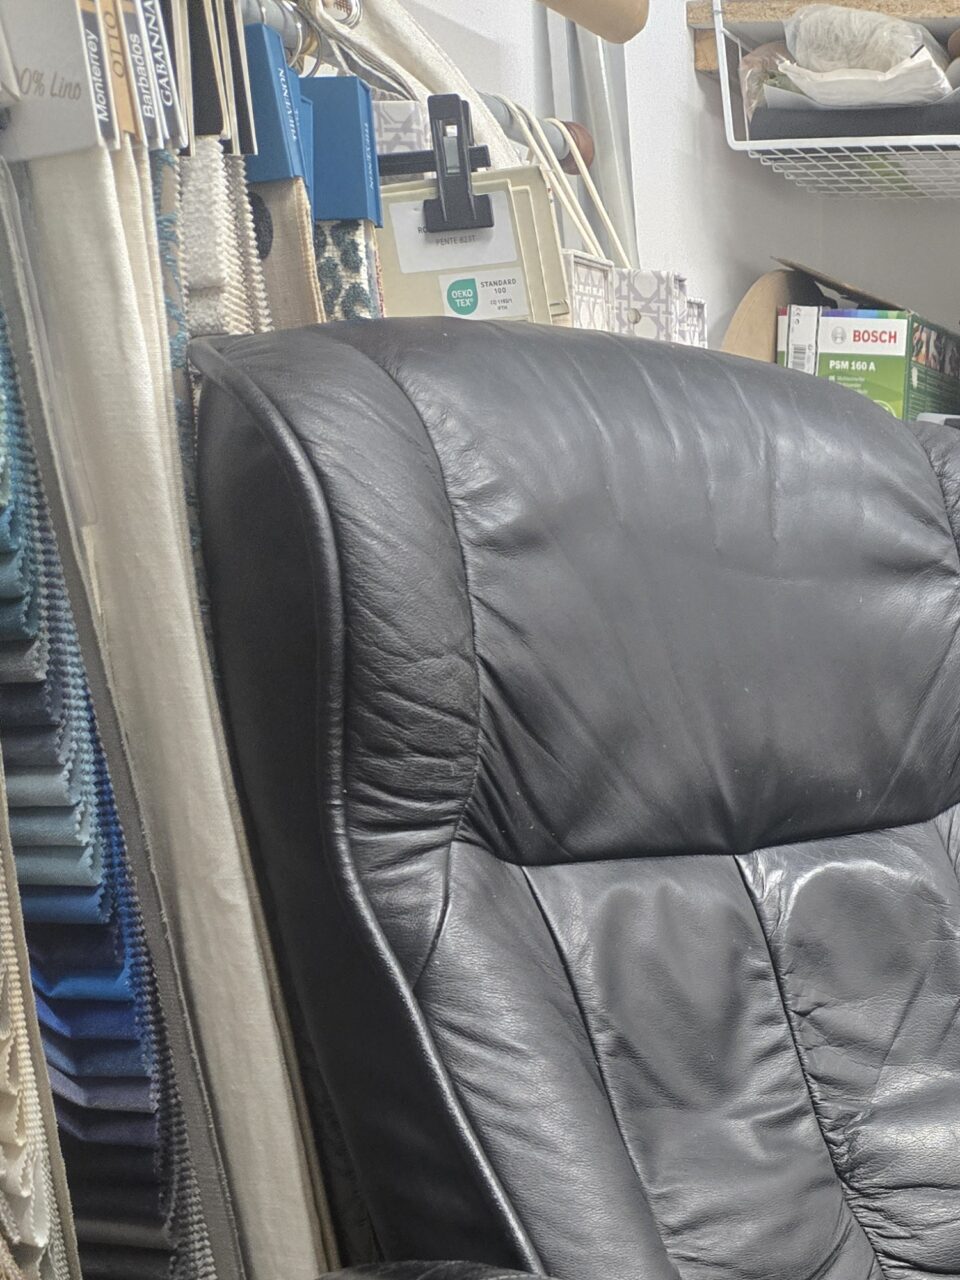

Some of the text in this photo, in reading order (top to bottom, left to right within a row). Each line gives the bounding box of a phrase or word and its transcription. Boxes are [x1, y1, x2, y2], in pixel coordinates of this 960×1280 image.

[103, 11, 125, 78] OTTO
[144, 0, 173, 106] GABANNA
[19, 67, 45, 97] 0%
[86, 29, 109, 122] Monterrey
[130, 33, 154, 118] Barbados
[451, 288, 473, 299] OEKO
[480, 278, 517, 288] STANDARD
[852, 329, 897, 344] BOSCH
[829, 359, 876, 371] PSM 160 A
